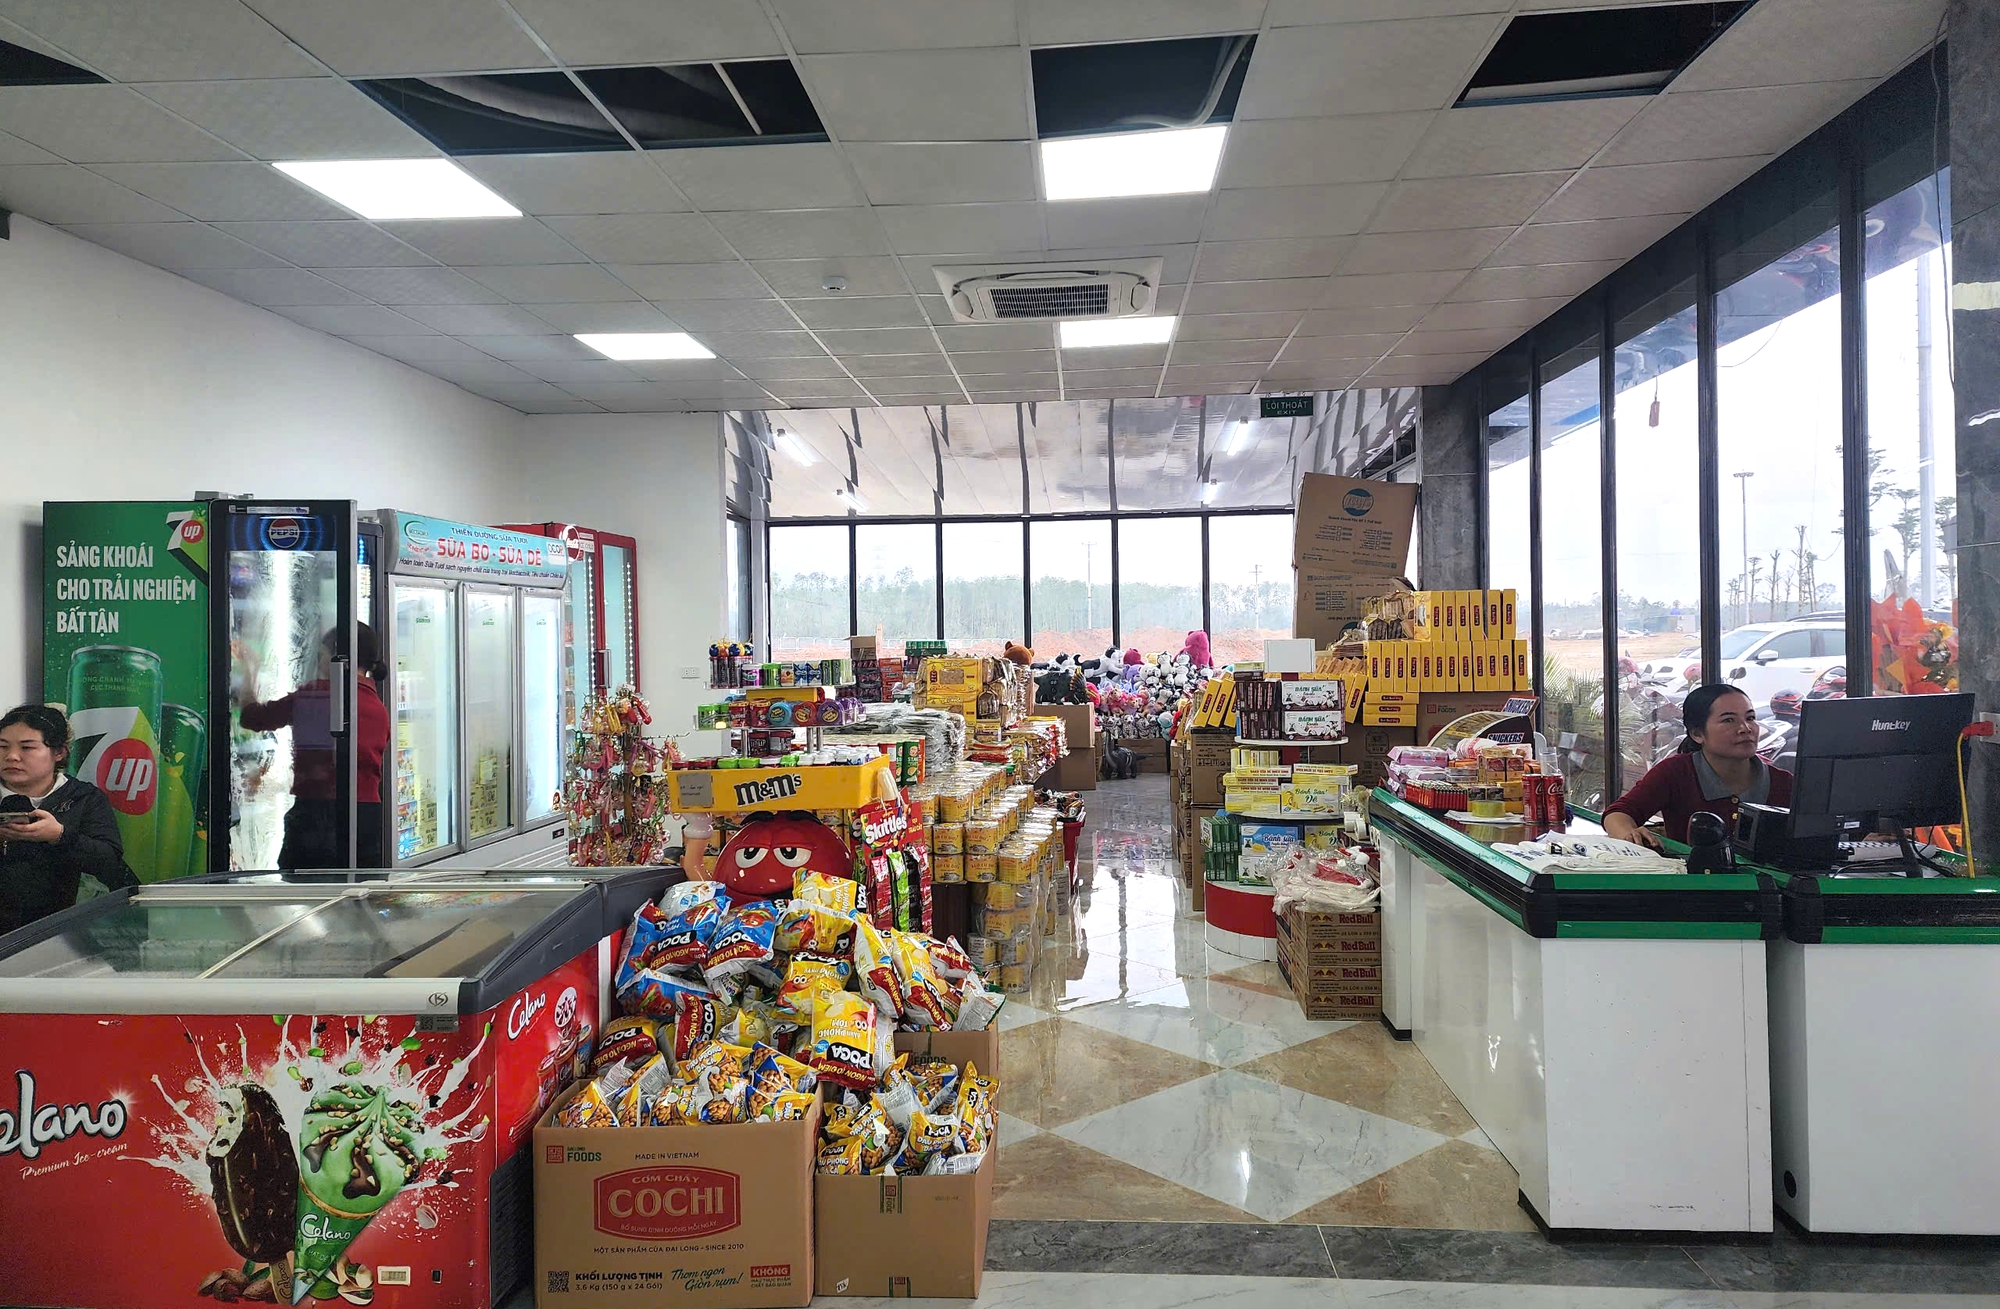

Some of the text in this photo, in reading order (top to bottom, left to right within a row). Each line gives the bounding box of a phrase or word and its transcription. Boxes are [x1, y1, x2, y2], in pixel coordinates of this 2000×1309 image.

[1281, 399, 1308, 409] THOÁT
[270, 528, 298, 536] PEPSI
[451, 527, 473, 537] THIÊN
[56, 540, 154, 568] SẢNG KHOÁI
[437, 536, 466, 559] SỮA
[471, 540, 489, 562] BÒ
[498, 544, 524, 566] SỮA
[527, 547, 542, 566] DÊ
[56, 573, 196, 605] CHO TRẢI NGHIỆM
[56, 606, 119, 637] BẤT TẬN
[1503, 698, 1535, 715] SNICKERS
[1488, 732, 1525, 743] SNICKERS
[865, 813, 908, 846] Skittles
[1264, 833, 1282, 843] Bánh
[657, 930, 692, 952] POCA
[507, 991, 547, 1041] Celano
[702, 1002, 714, 1041] POCA
[608, 1048, 618, 1058] 10
[617, 1040, 638, 1054] NGON
[830, 1043, 872, 1071] POCA
[816, 1061, 868, 1083] NGON 10 ĐIỂM
[0, 1069, 127, 1160] elano
[19, 1143, 128, 1180] Premium Ice-cream
[567, 1151, 602, 1163] FOODS
[667, 1151, 700, 1160] VIETNAM
[631, 1173, 700, 1184] CƠM CHÁY
[607, 1186, 725, 1219] COCHI
[300, 1213, 351, 1242] Celano
[593, 1246, 609, 1254] MỘT
[610, 1246, 625, 1254] SẢN
[626, 1245, 647, 1253] PHẨM
[648, 1245, 664, 1253] CỦA
[665, 1246, 678, 1254] ĐẠI
[575, 1269, 663, 1283] KHỐI LƯỢNG TỊNH
[700, 1267, 726, 1281] ngon
[752, 1266, 789, 1276] KHÔNG
[589, 1283, 600, 1291] Kg
[602, 1283, 619, 1291] (150
[646, 1282, 663, 1290] Gói)
[685, 1271, 744, 1292] Giòn rụm!
